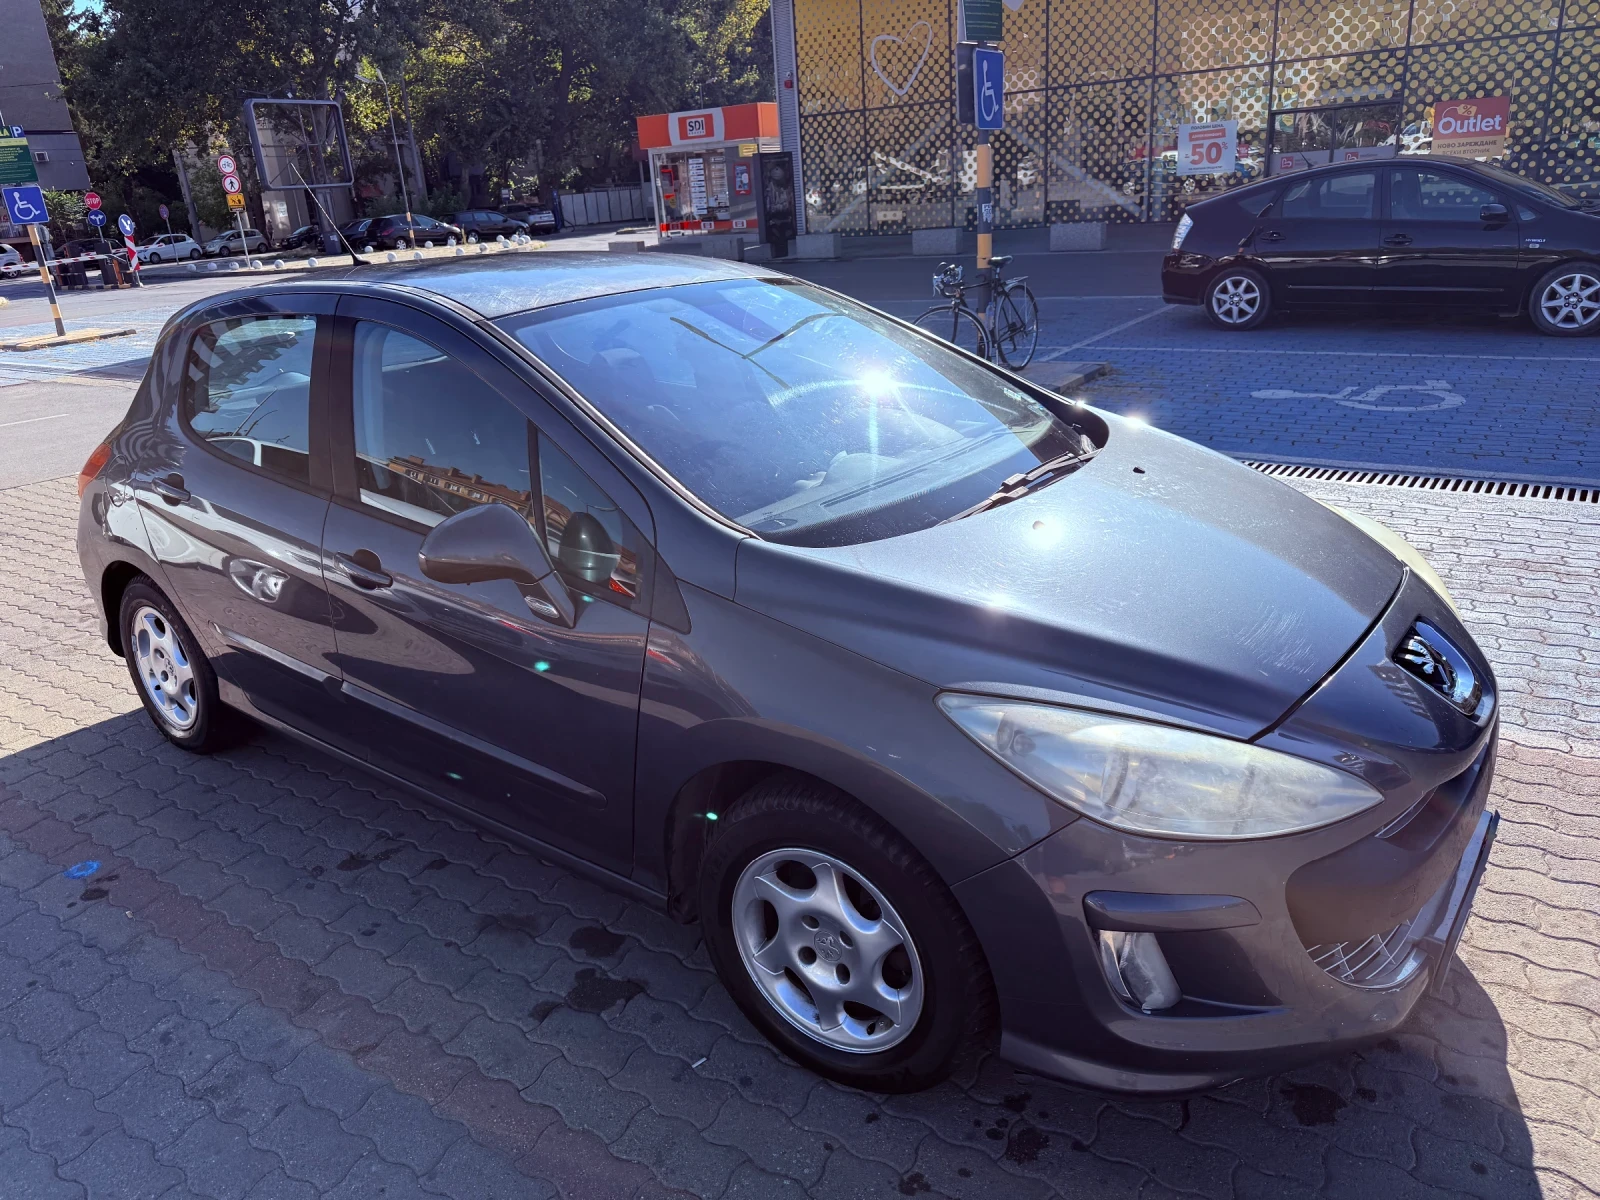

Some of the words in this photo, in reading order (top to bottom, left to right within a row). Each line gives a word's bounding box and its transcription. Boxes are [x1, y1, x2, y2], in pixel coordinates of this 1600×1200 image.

[688, 120, 704, 131] SDI
[1438, 115, 1502, 134] Outlet
[12, 126, 22, 137] P
[1457, 140, 1497, 148] ЗАРЕЖДАНЕ
[86, 197, 100, 205] STOP
